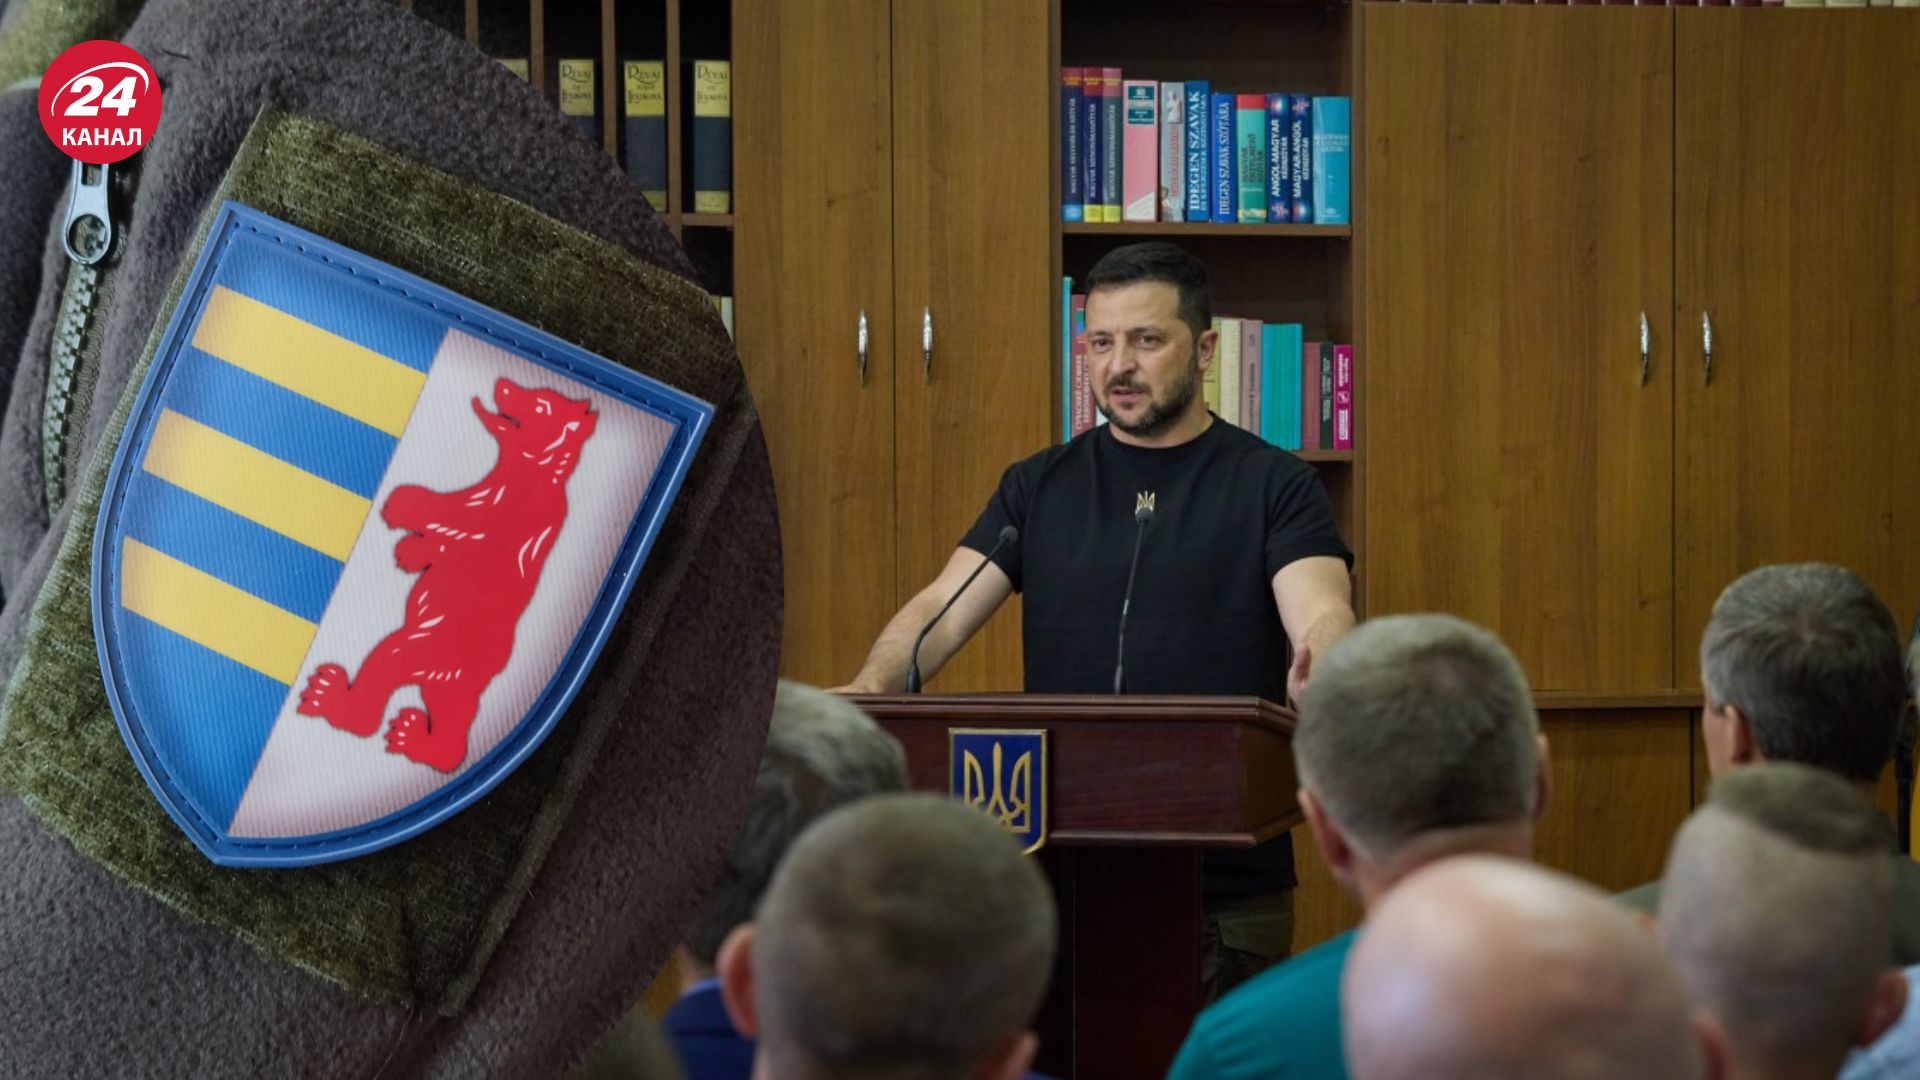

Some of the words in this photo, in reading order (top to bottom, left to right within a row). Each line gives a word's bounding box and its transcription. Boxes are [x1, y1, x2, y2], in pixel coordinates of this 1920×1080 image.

[1189, 91, 1200, 149] SZAVAK
[1189, 152, 1200, 210] IDEGEN
[1219, 146, 1230, 178] SZAVAK
[1271, 118, 1280, 197] ANGOL-MAGYAR
[1292, 120, 1302, 198] MAGYAR-ANGOL
[1219, 179, 1230, 215] IDEGEN
